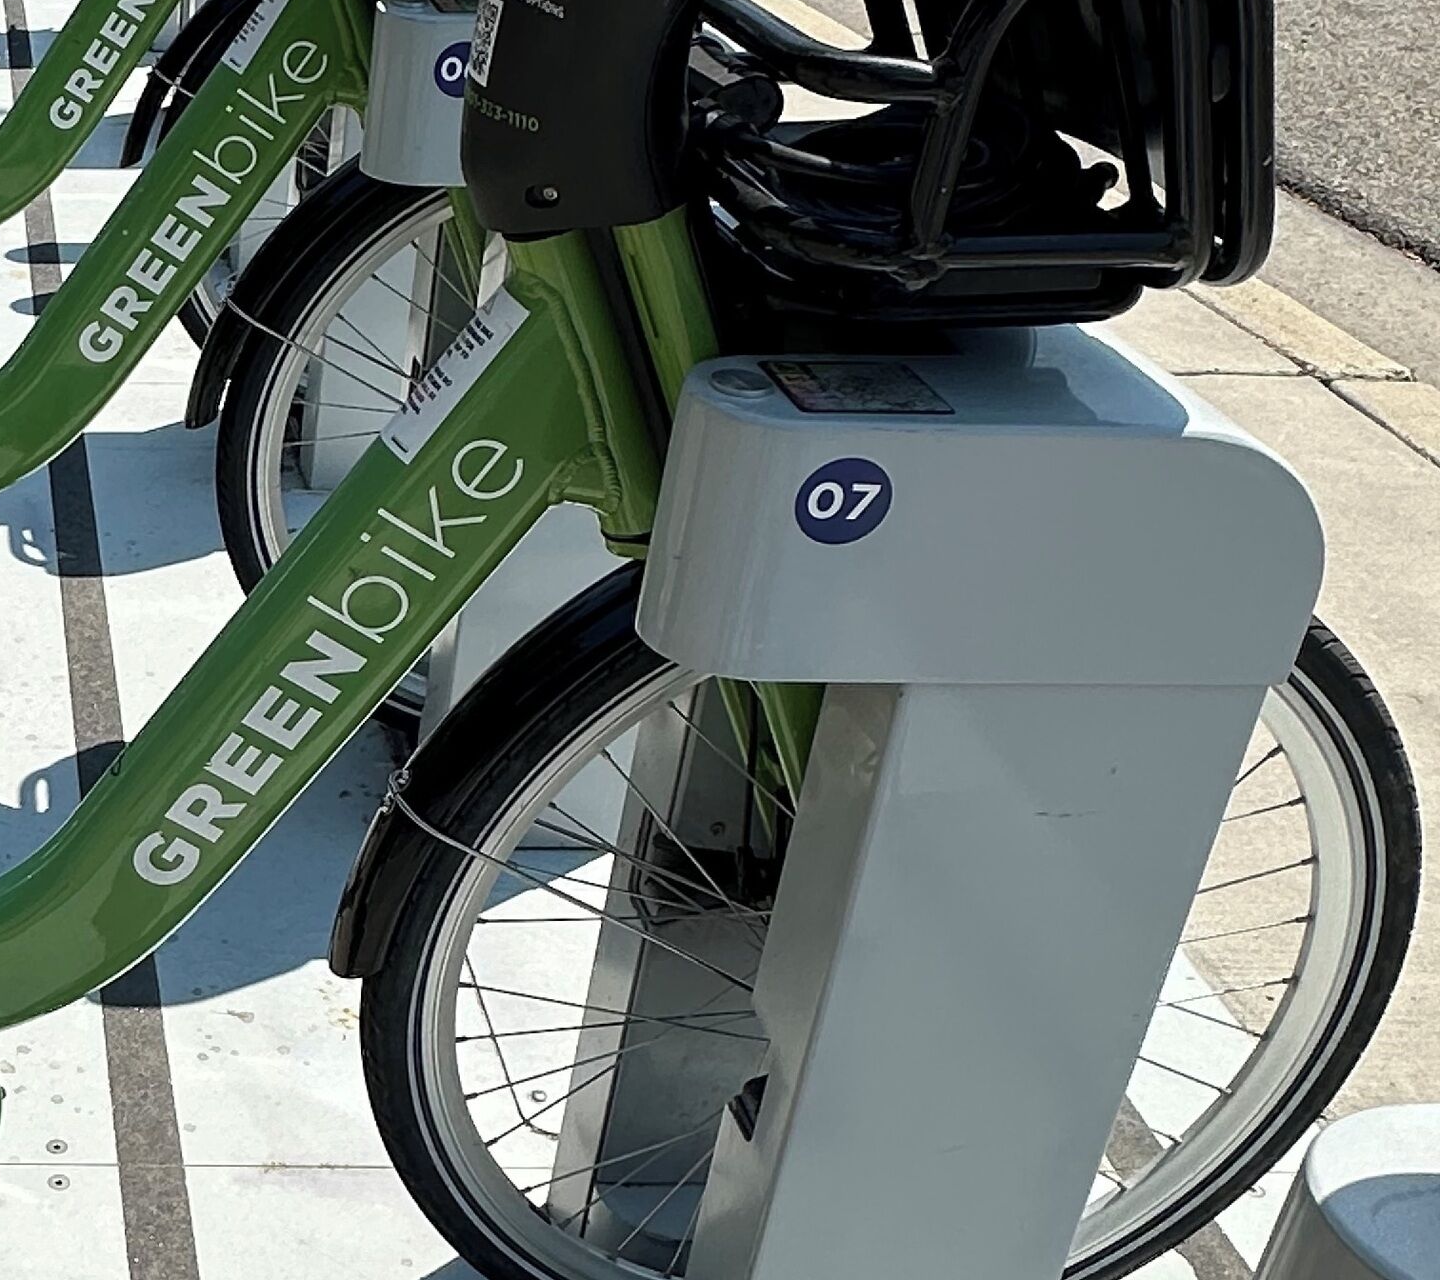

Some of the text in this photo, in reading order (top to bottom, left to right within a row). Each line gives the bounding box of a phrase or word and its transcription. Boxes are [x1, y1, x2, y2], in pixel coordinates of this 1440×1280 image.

[440, 56, 471, 82] 0
[78, 40, 328, 363] GREENbike
[807, 481, 882, 521] 07
[133, 438, 524, 887] GREENbike
